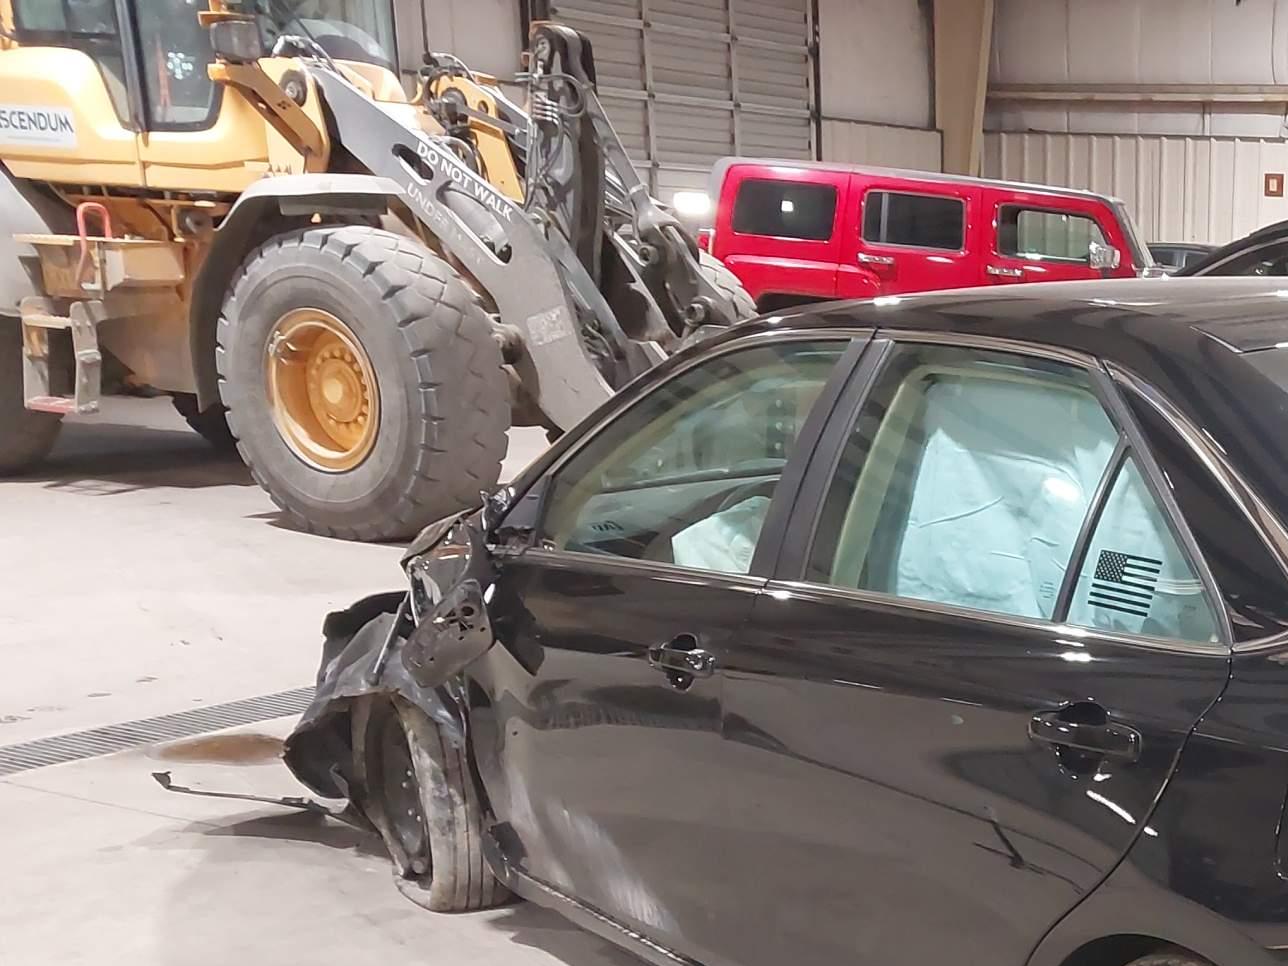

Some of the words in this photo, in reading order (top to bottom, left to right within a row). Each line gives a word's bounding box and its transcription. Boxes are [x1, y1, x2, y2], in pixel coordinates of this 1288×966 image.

[0, 110, 74, 133] SCENDUM
[416, 141, 438, 164] DO
[440, 159, 472, 188] NOT
[474, 183, 513, 222] WALK
